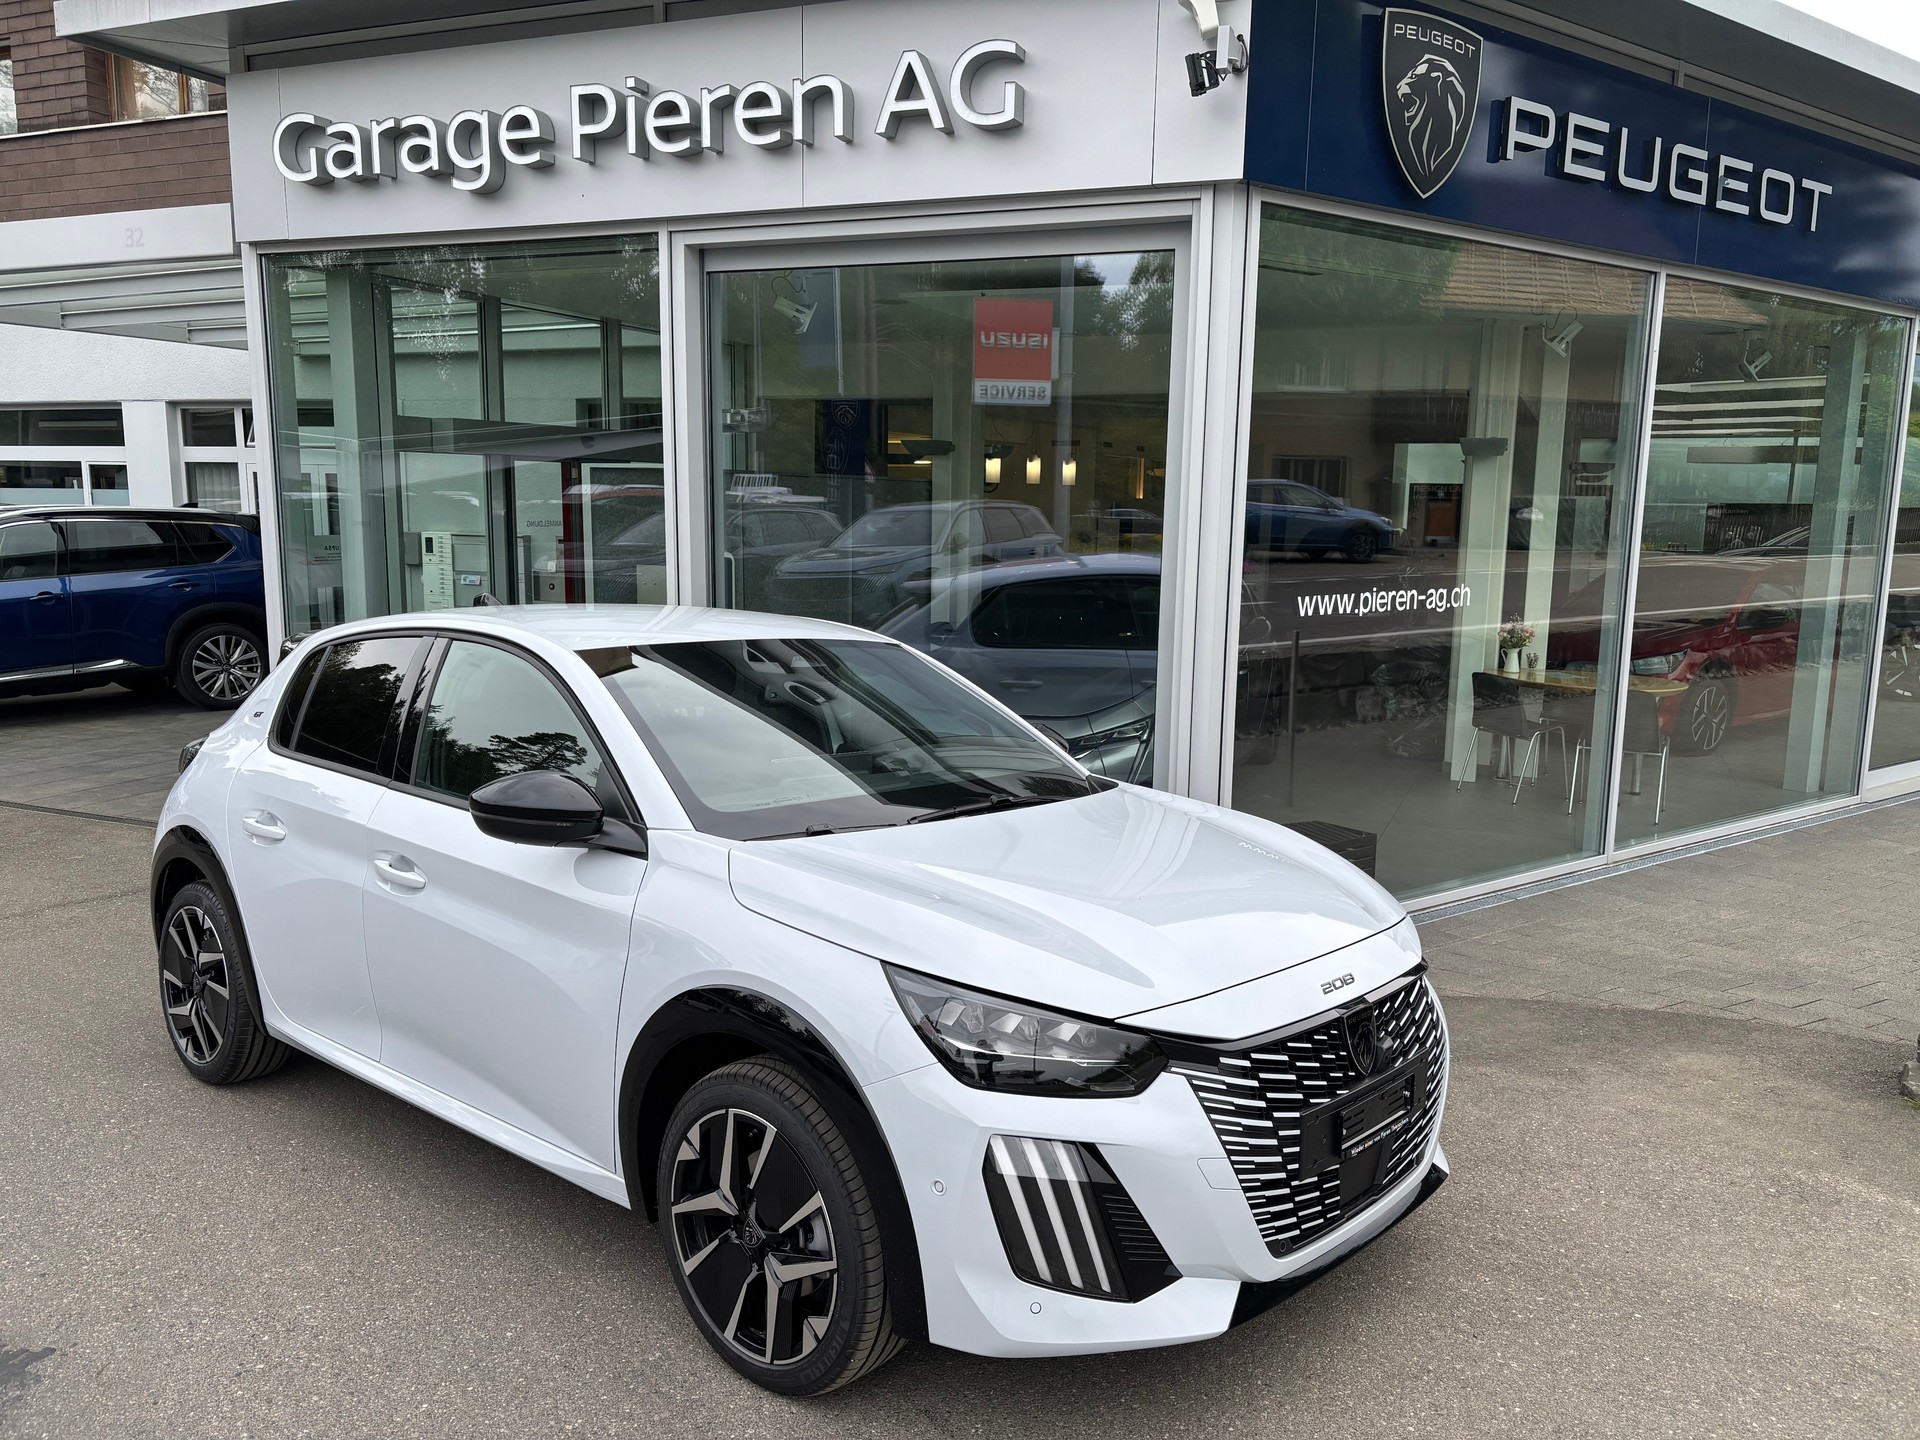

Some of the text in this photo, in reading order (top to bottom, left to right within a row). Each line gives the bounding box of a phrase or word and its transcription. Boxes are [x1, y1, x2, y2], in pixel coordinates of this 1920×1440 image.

[1393, 23, 1476, 58] PEUGEOT
[272, 39, 1024, 194] Garage Pieren AG
[1504, 95, 1833, 232] PEUGEOT
[125, 227, 145, 248] 32
[1297, 583, 1471, 617] www.pieren-ag.ch
[1320, 972, 1355, 995] 208
